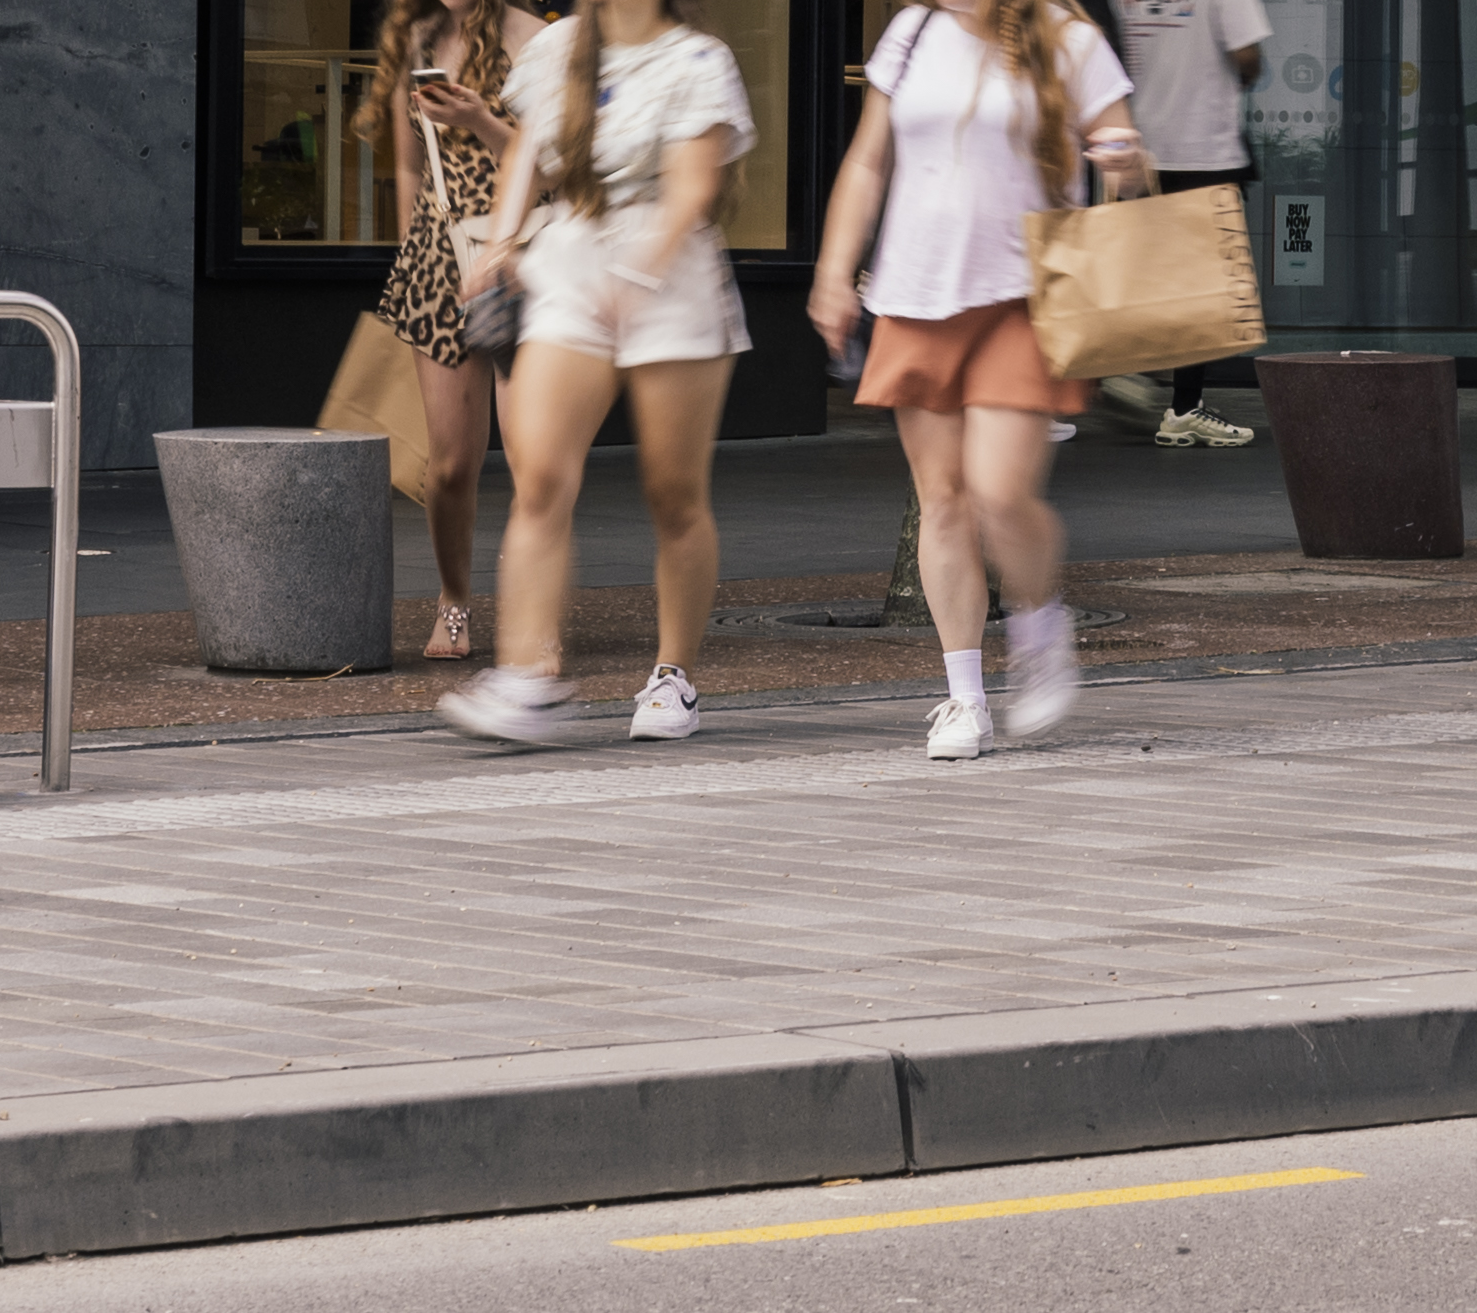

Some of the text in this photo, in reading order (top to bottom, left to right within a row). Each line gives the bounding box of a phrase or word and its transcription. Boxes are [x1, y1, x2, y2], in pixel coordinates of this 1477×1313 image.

[1288, 203, 1309, 216] BUY
[1286, 216, 1311, 228] NOW
[1289, 228, 1308, 240] PAY
[1283, 240, 1313, 253] LATER
